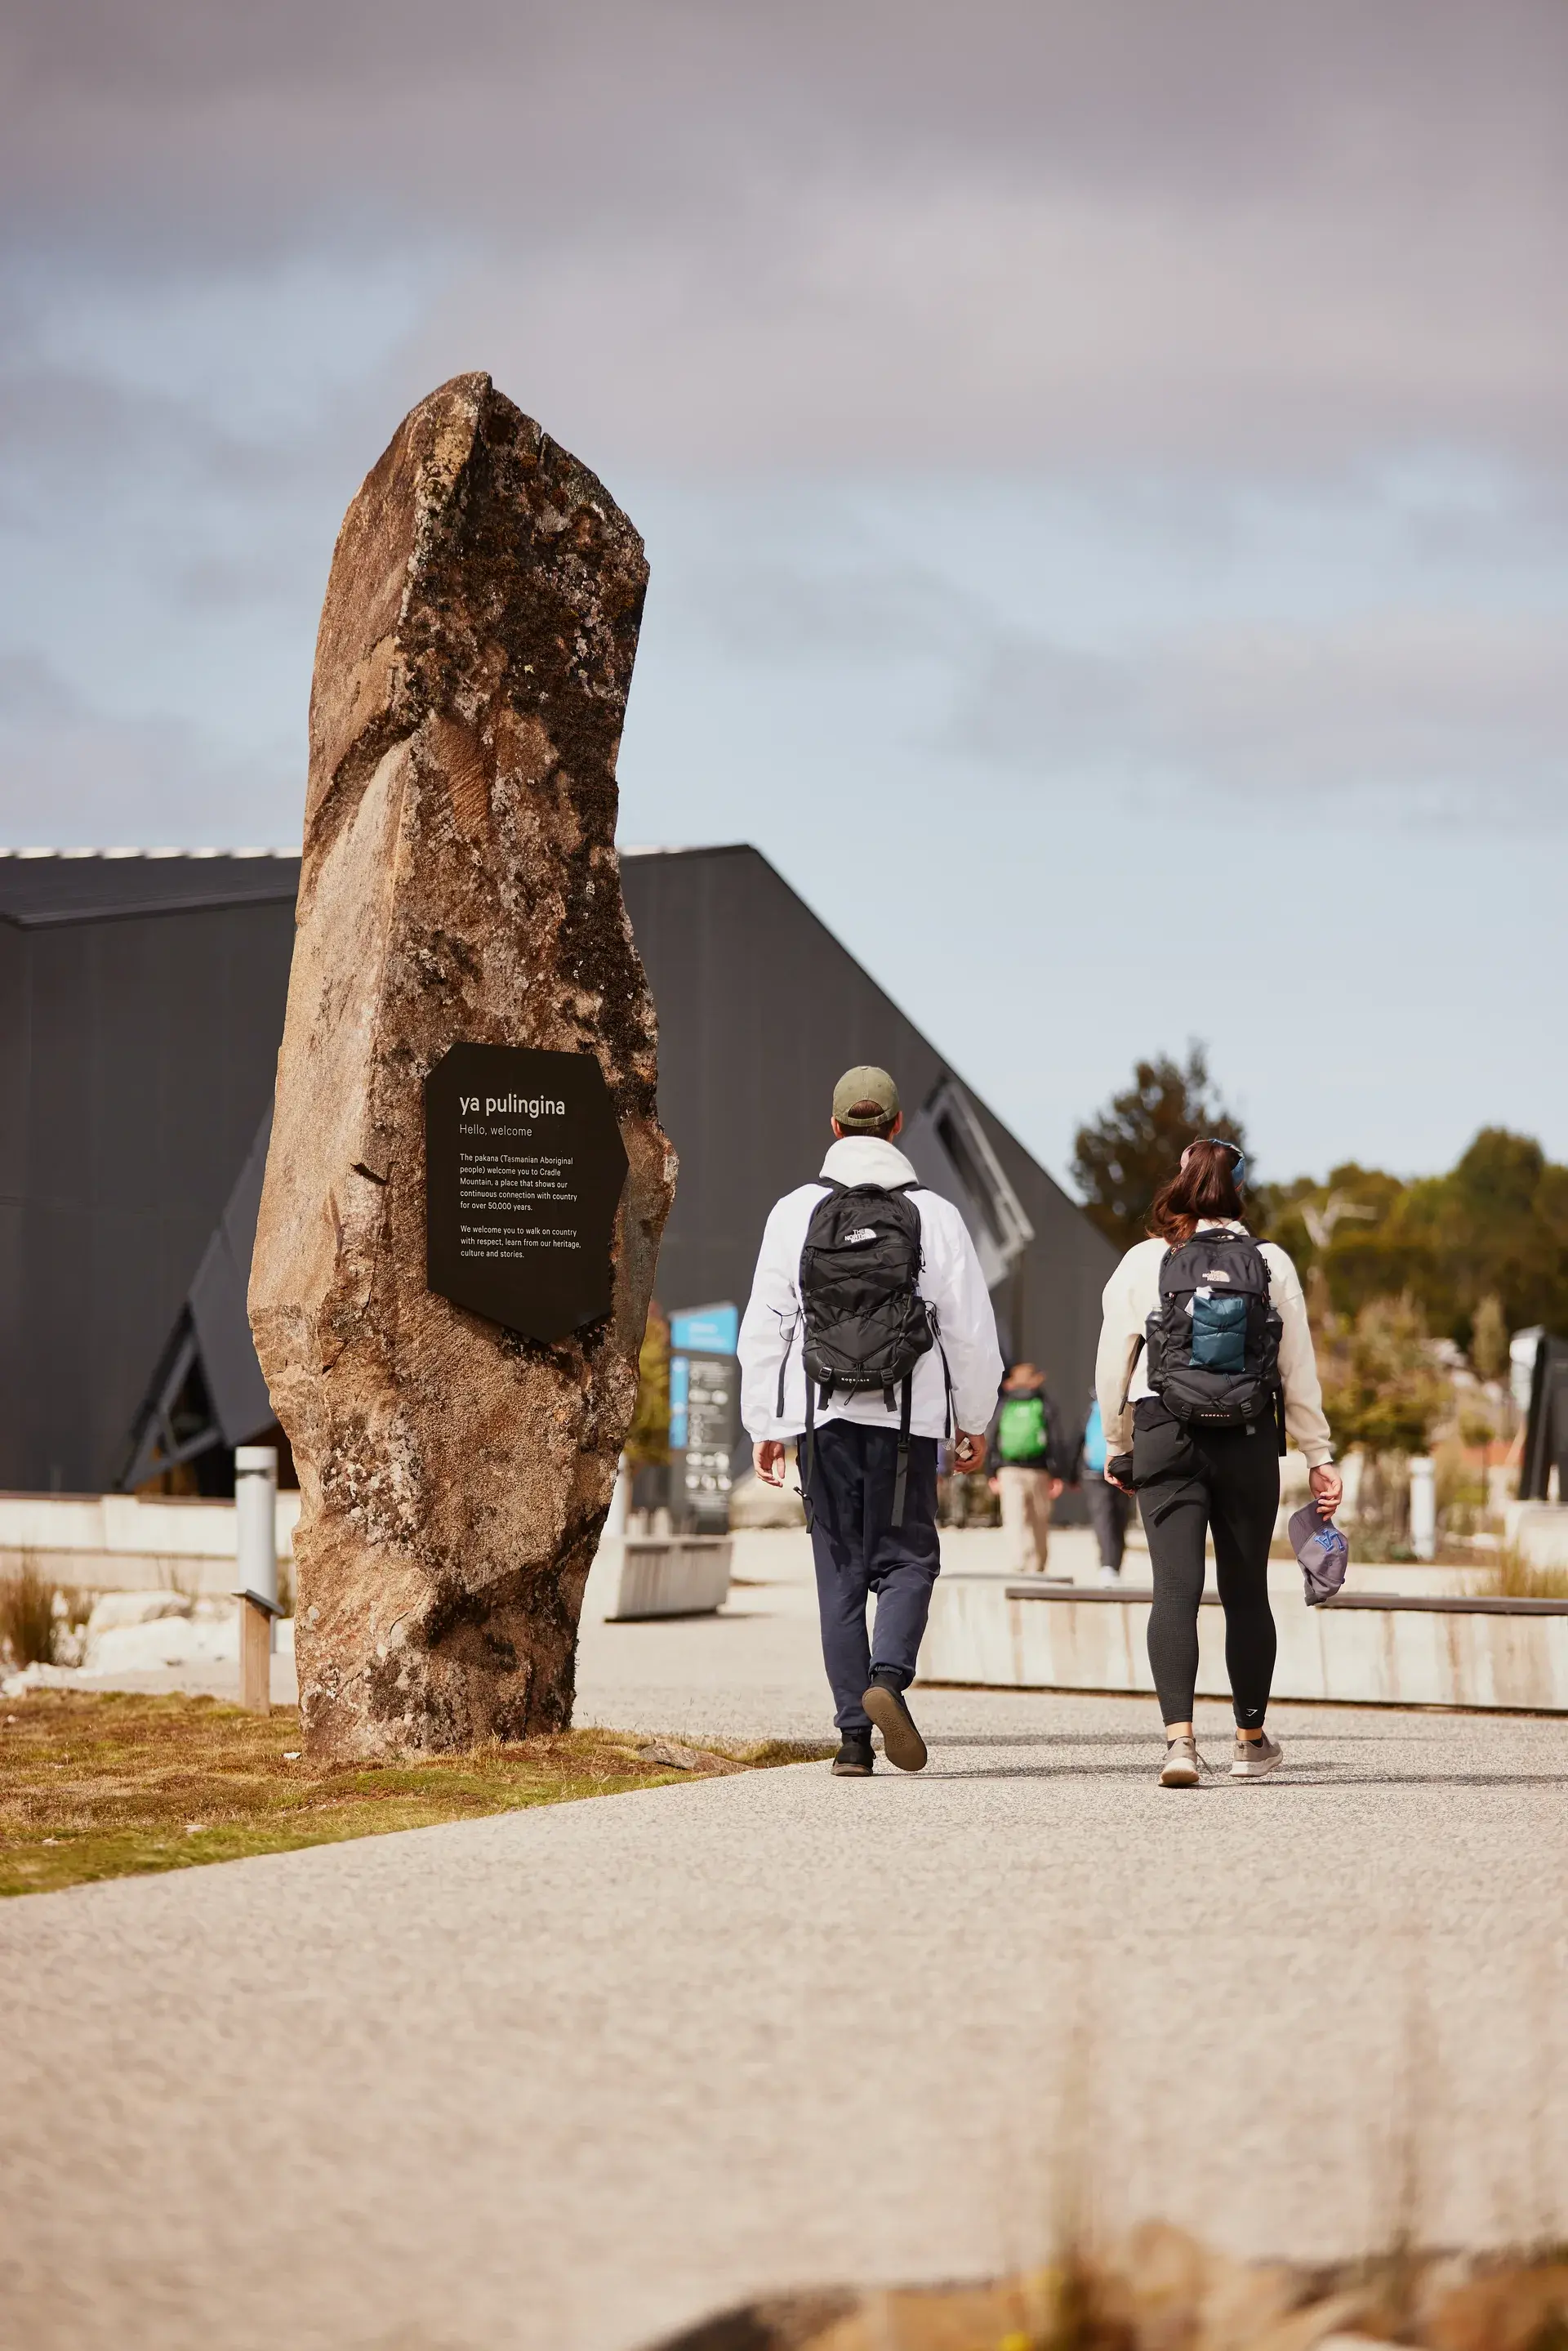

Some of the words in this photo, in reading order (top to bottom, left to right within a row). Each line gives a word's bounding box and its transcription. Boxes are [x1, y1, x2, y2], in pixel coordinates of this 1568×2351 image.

[459, 1097, 479, 1115] ya
[486, 1094, 565, 1118] pulingina
[460, 1124, 488, 1136] Hello,
[490, 1126, 532, 1136] welcome
[460, 1153, 473, 1162] The
[474, 1154, 499, 1162] pakana
[500, 1155, 538, 1163] (Tasmanian
[540, 1157, 573, 1166] Aboriginal
[460, 1167, 486, 1175] people)
[487, 1167, 516, 1175] welcome
[539, 1168, 561, 1176] Cradle
[460, 1178, 493, 1186] Mountain,
[500, 1179, 519, 1188] place
[460, 1190, 497, 1198] continuous
[460, 1201, 470, 1209] for
[488, 1202, 512, 1211] 50,000
[472, 1225, 502, 1233] welcome
[525, 1227, 541, 1235] walk
[551, 1229, 577, 1238] country
[523, 1238, 539, 1247] from
[552, 1240, 581, 1249] heritage,
[460, 1249, 485, 1257] culture
[500, 1250, 524, 1258] stories.
